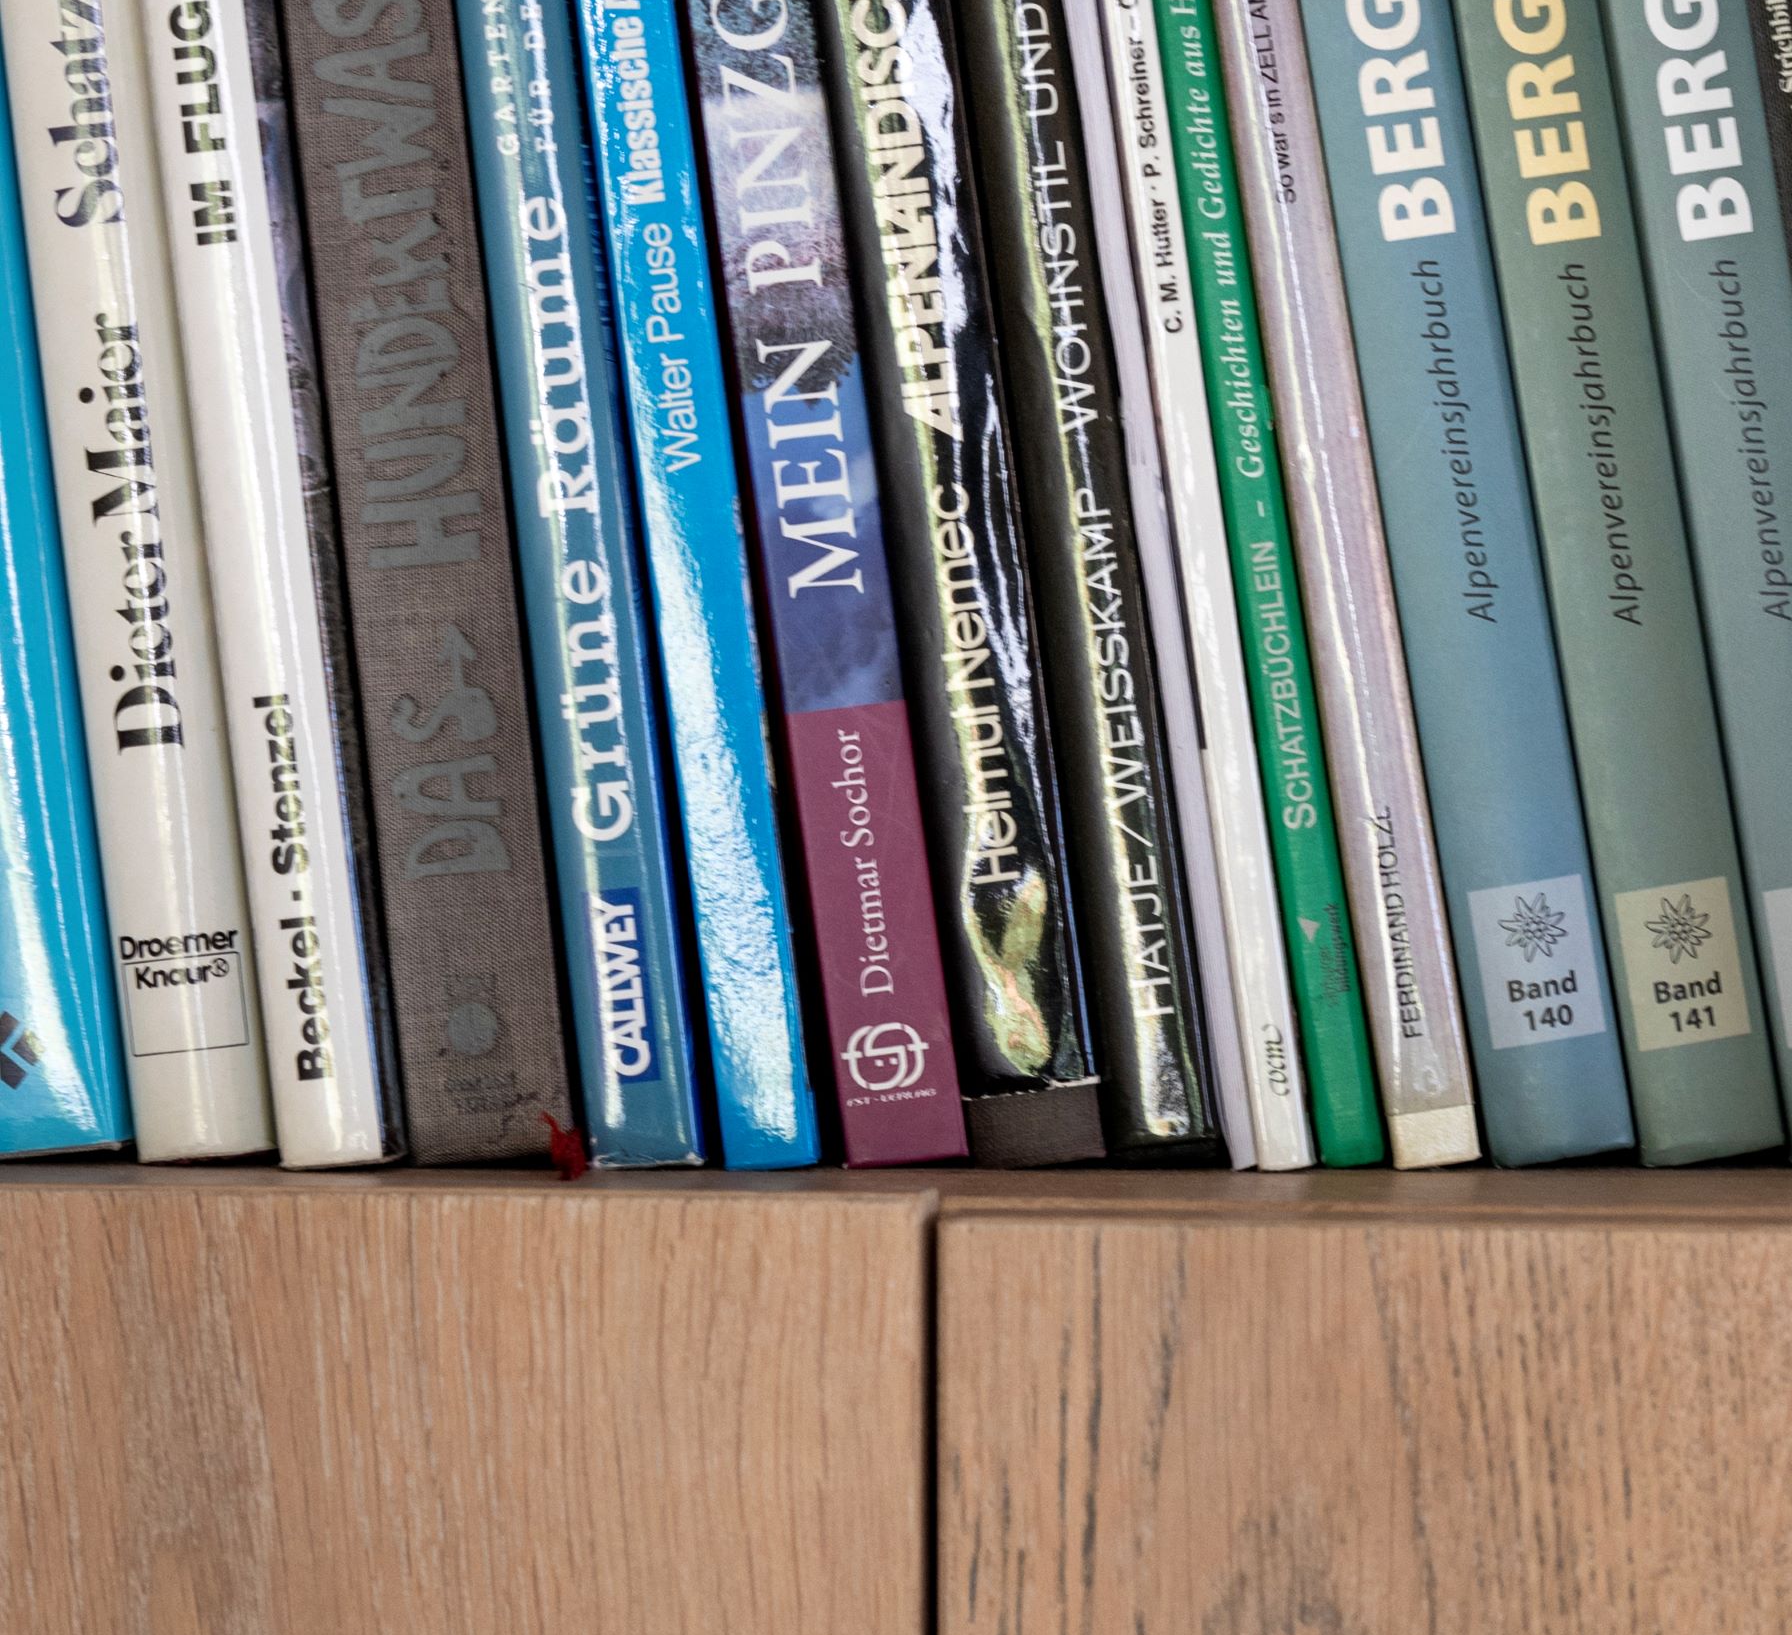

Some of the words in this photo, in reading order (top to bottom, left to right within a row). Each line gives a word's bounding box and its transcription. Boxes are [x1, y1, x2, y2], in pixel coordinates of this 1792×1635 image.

[616, 16, 667, 203] Klassische
[1014, 1, 1061, 117] UND
[1124, 35, 1156, 147] Schreiner
[1175, 23, 1207, 76] aus
[1250, 31, 1279, 84] ZELL
[1257, 88, 1283, 107] in
[525, 76, 558, 151] FÜR
[1141, 152, 1161, 176] P.
[1184, 85, 1229, 219] Gedichte
[190, 182, 237, 246] IM
[1146, 196, 1175, 267] Hutter
[1204, 227, 1236, 287] und
[644, 222, 686, 342] Pause
[1030, 141, 1100, 434] WOHNSTIL
[1158, 274, 1180, 302] M.
[1163, 310, 1186, 333] C.
[514, 196, 600, 517] Räume
[655, 355, 702, 472] Walter
[1214, 295, 1266, 478] Geschichten
[78, 312, 159, 525] Maier
[755, 336, 864, 598] MEIN
[1411, 257, 1499, 623] Alpenvereinsjahrbuch
[1559, 261, 1643, 625] Alpenvereinsjahrbuch
[109, 530, 186, 750] Dieter
[927, 483, 1001, 691] Nemec
[555, 558, 634, 841] Grüne
[1248, 539, 1316, 828] SCHATZBÜCHLEIN
[252, 692, 309, 875] Stenzel
[831, 728, 876, 848] Sochor
[950, 705, 1022, 881] Helmut
[119, 928, 239, 959] Droemer
[597, 895, 653, 1074] CALLWEY
[852, 857, 897, 996] Dietmar
[1381, 891, 1425, 1038] FERDINAND
[1507, 968, 1579, 1003] Band
[1653, 969, 1724, 1003] Band
[280, 915, 334, 1080] Beckel
[1523, 1002, 1574, 1032] 140
[1668, 1004, 1718, 1032] 141
